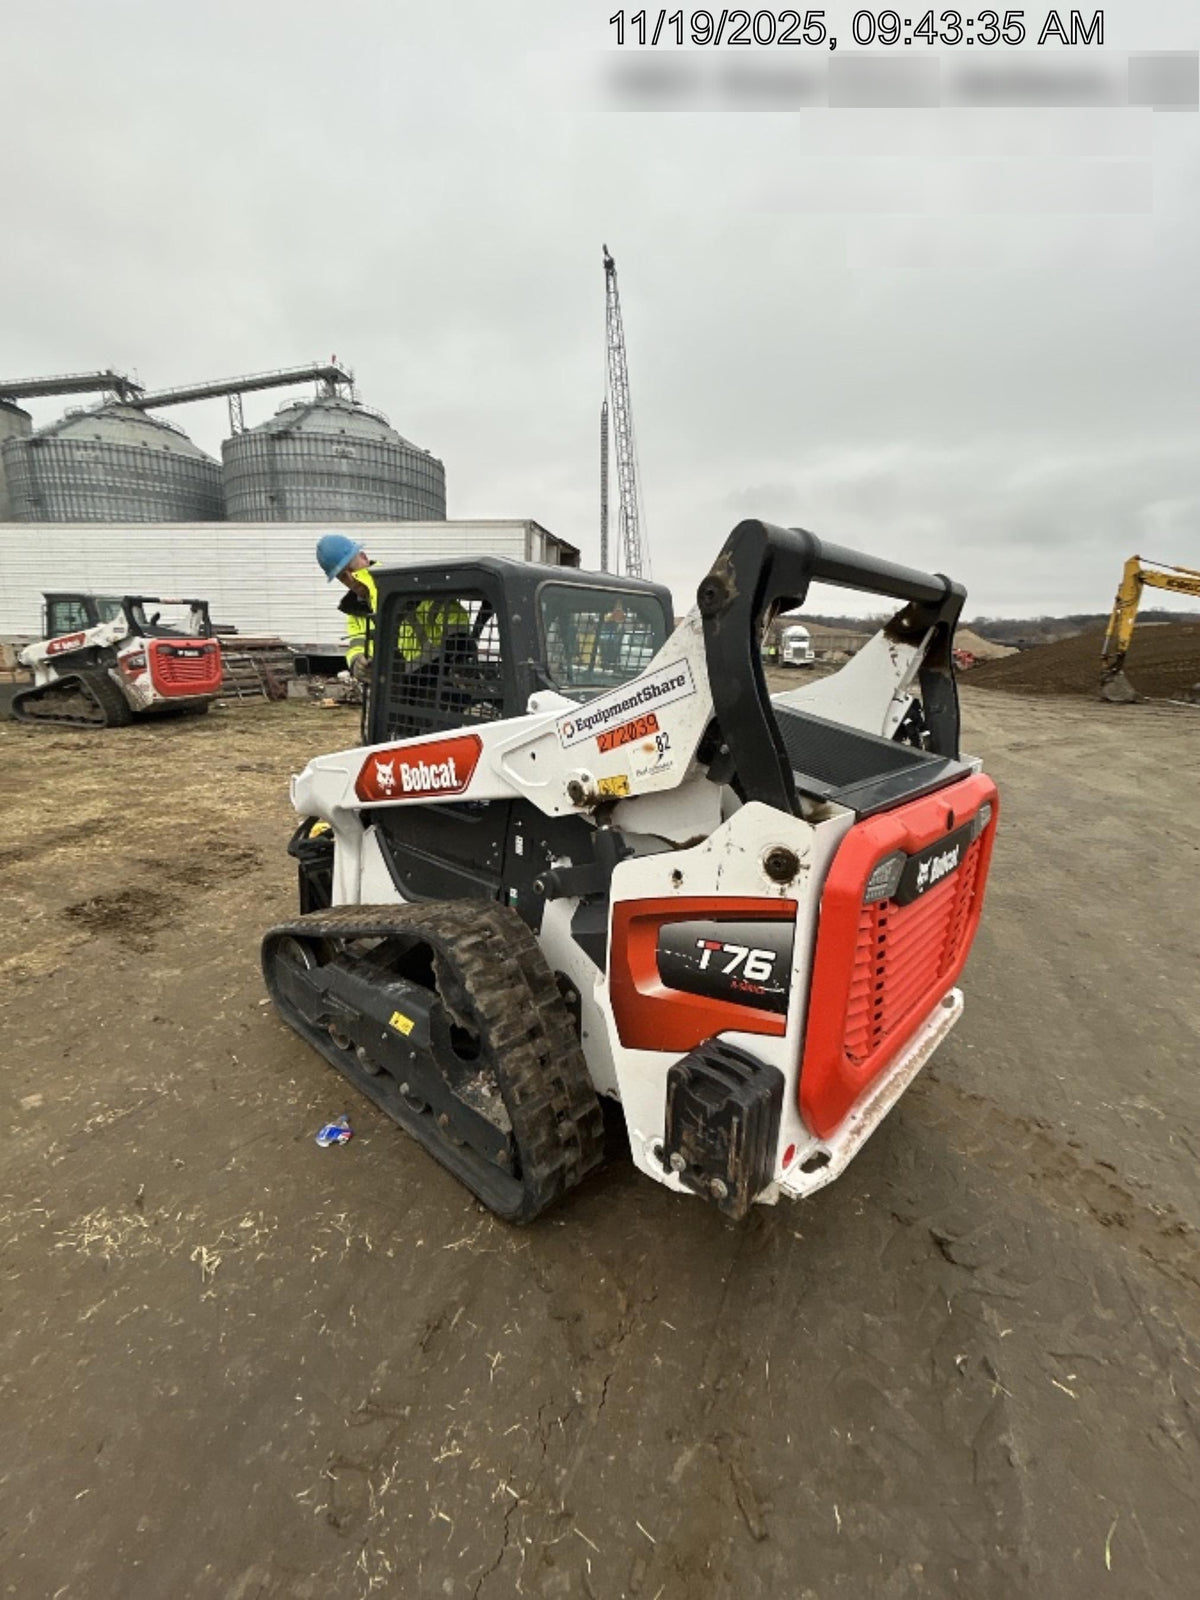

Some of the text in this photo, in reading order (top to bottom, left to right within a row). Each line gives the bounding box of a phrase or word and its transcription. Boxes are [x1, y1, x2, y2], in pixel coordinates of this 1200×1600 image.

[575, 673, 686, 732] EquipmentShare
[399, 757, 458, 792] Bobcat
[696, 939, 777, 981] T76
